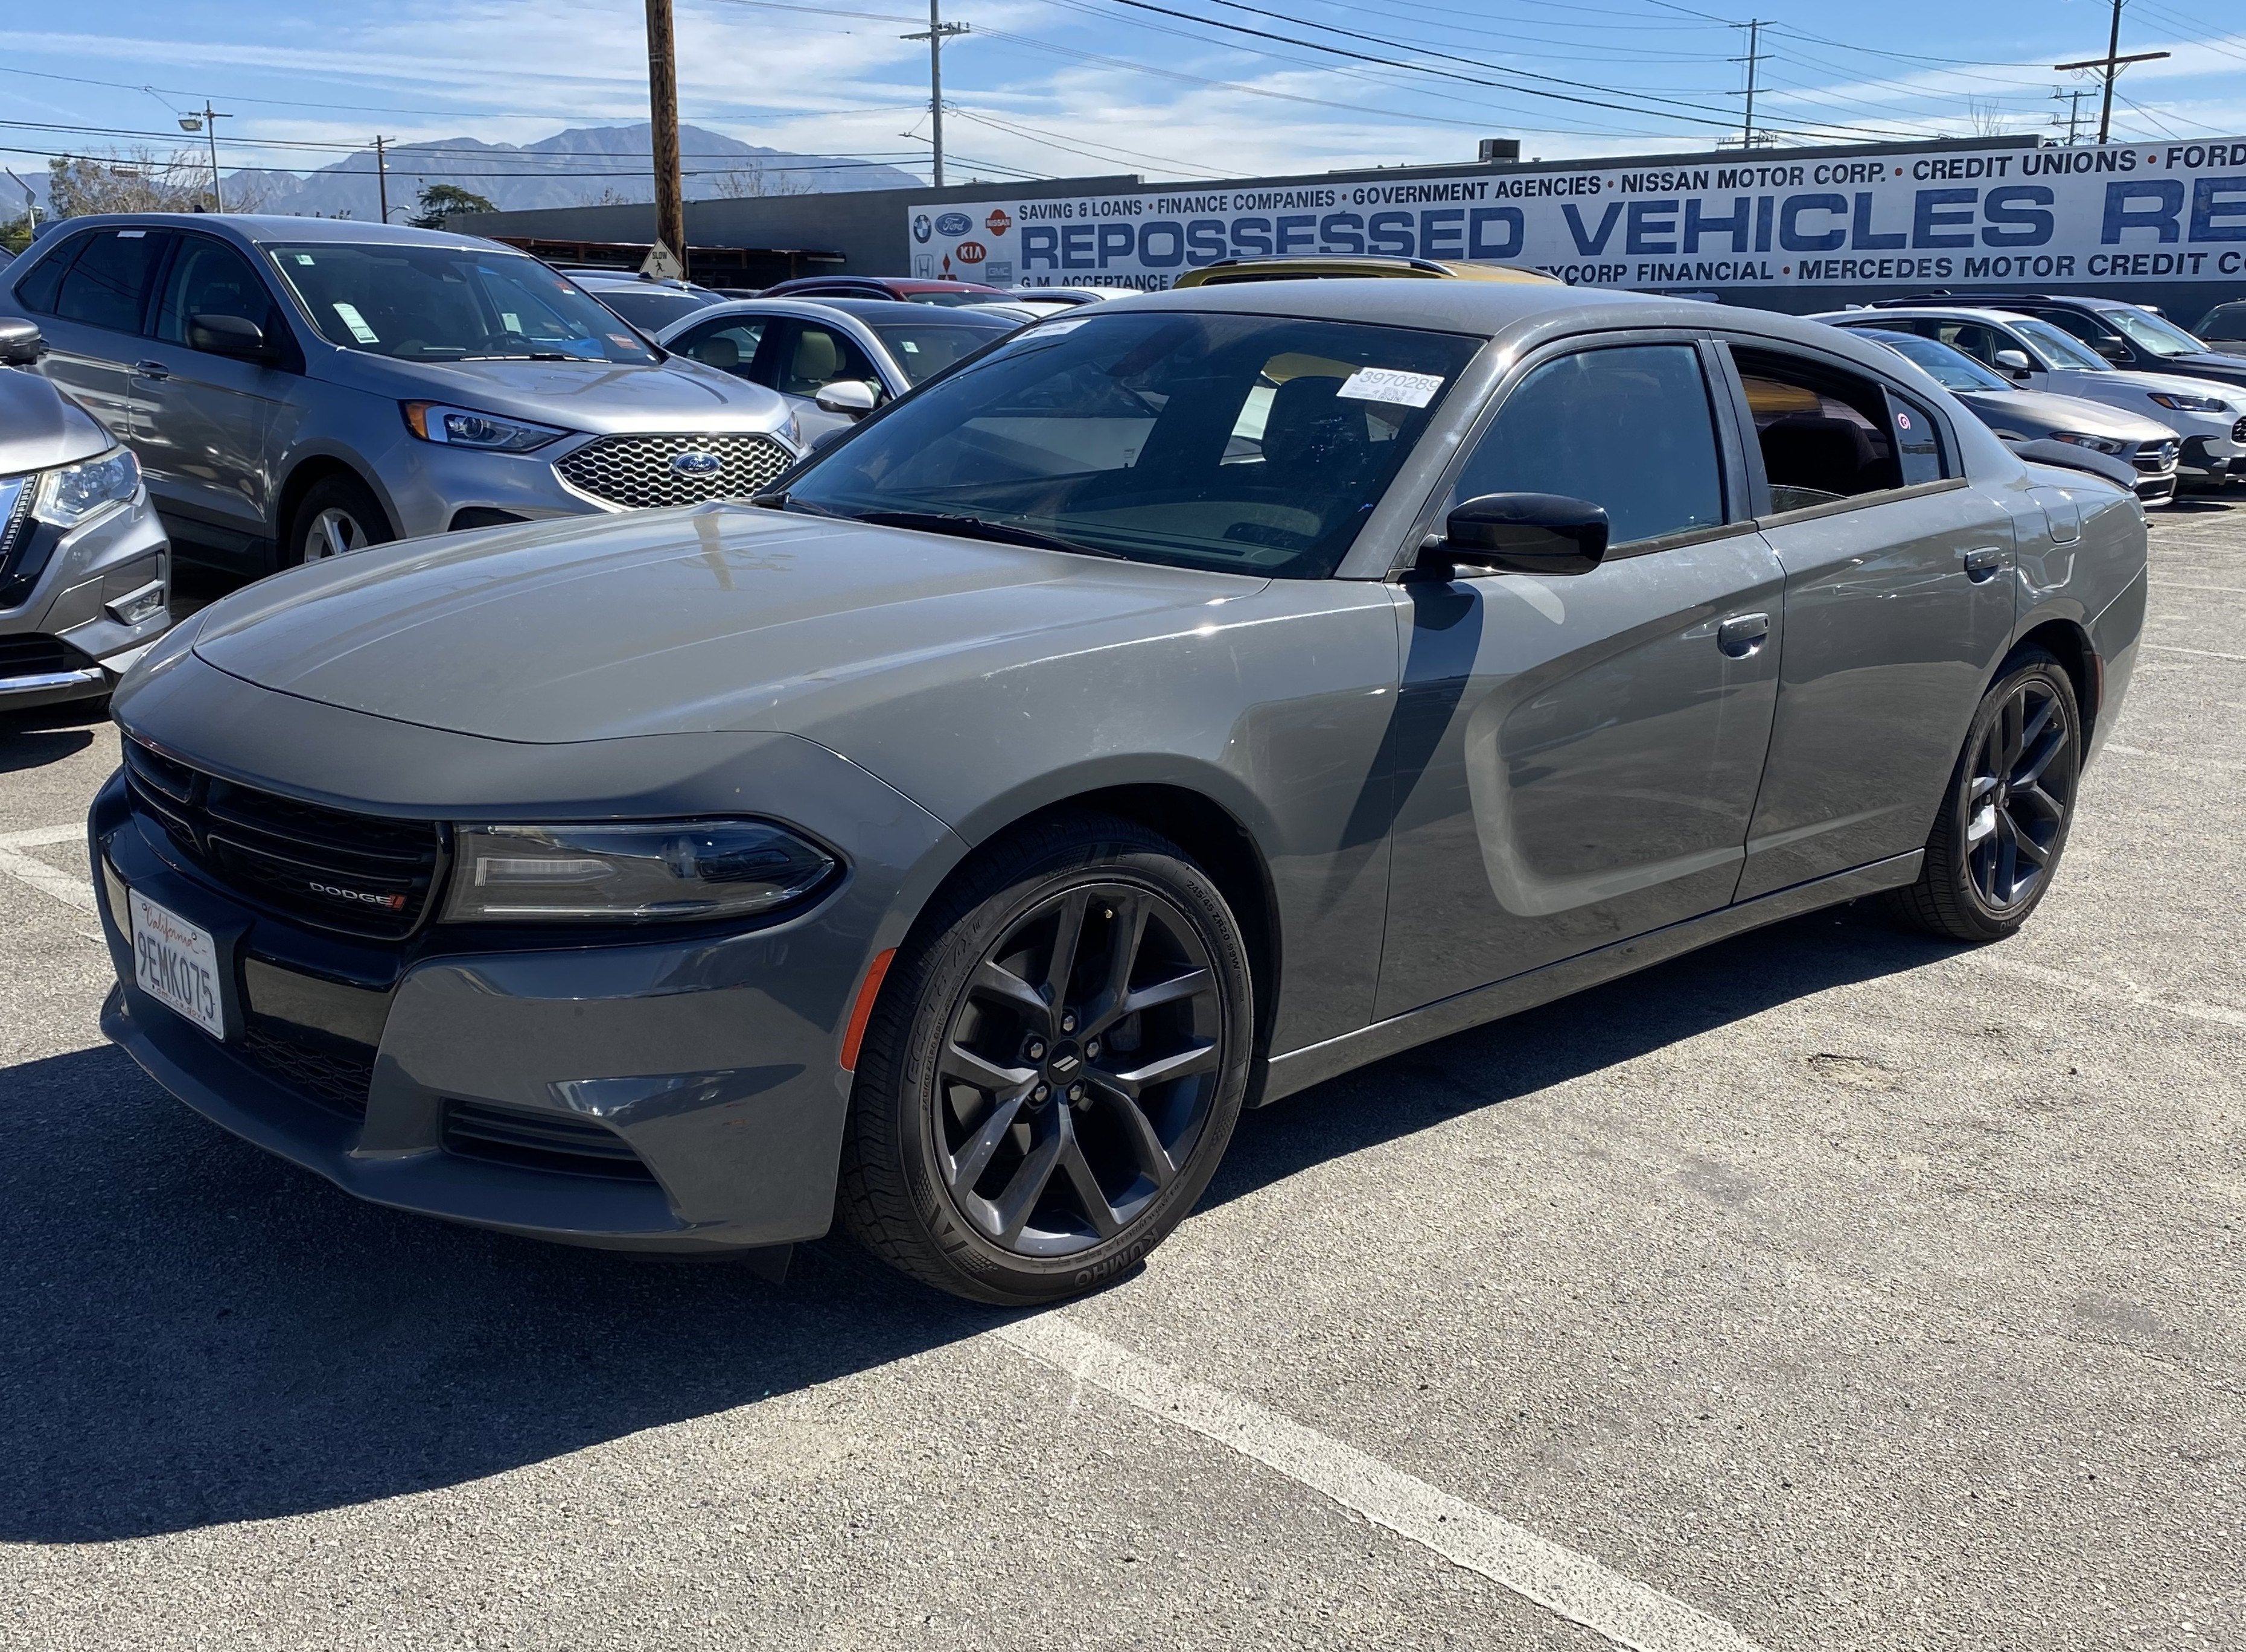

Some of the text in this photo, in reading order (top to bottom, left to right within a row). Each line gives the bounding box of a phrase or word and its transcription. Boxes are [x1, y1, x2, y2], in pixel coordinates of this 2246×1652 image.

[1019, 143, 2246, 220] SAVING & LOANS FINANCE COMPANIES GOVERNMENT AGENCIES NISSAN MOTOR CORP. CREDIT UNIONS FORD
[943, 217, 965, 231] Ford
[1021, 206, 1524, 270] REPOSSESSED
[1560, 185, 2055, 256] VEHICLES
[652, 251, 667, 260] SLOW
[960, 246, 984, 260] KIA
[1636, 260, 1774, 282] FINANCIAL
[1798, 257, 1953, 279] MERCEDES
[1964, 255, 2075, 278] MOTOR
[2088, 252, 2208, 276] CREDIT
[2218, 250, 2246, 275] C
[1062, 274, 1169, 292] ACCEPTANCE
[1359, 371, 1441, 392] 3970289
[309, 882, 393, 906] DODGE
[1187, 880, 1214, 912] 245/45
[1212, 912, 1230, 941] ZR20
[146, 906, 199, 954] California
[138, 931, 215, 1019] 9EMK075
[1074, 1227, 1160, 1287] KUMHO
